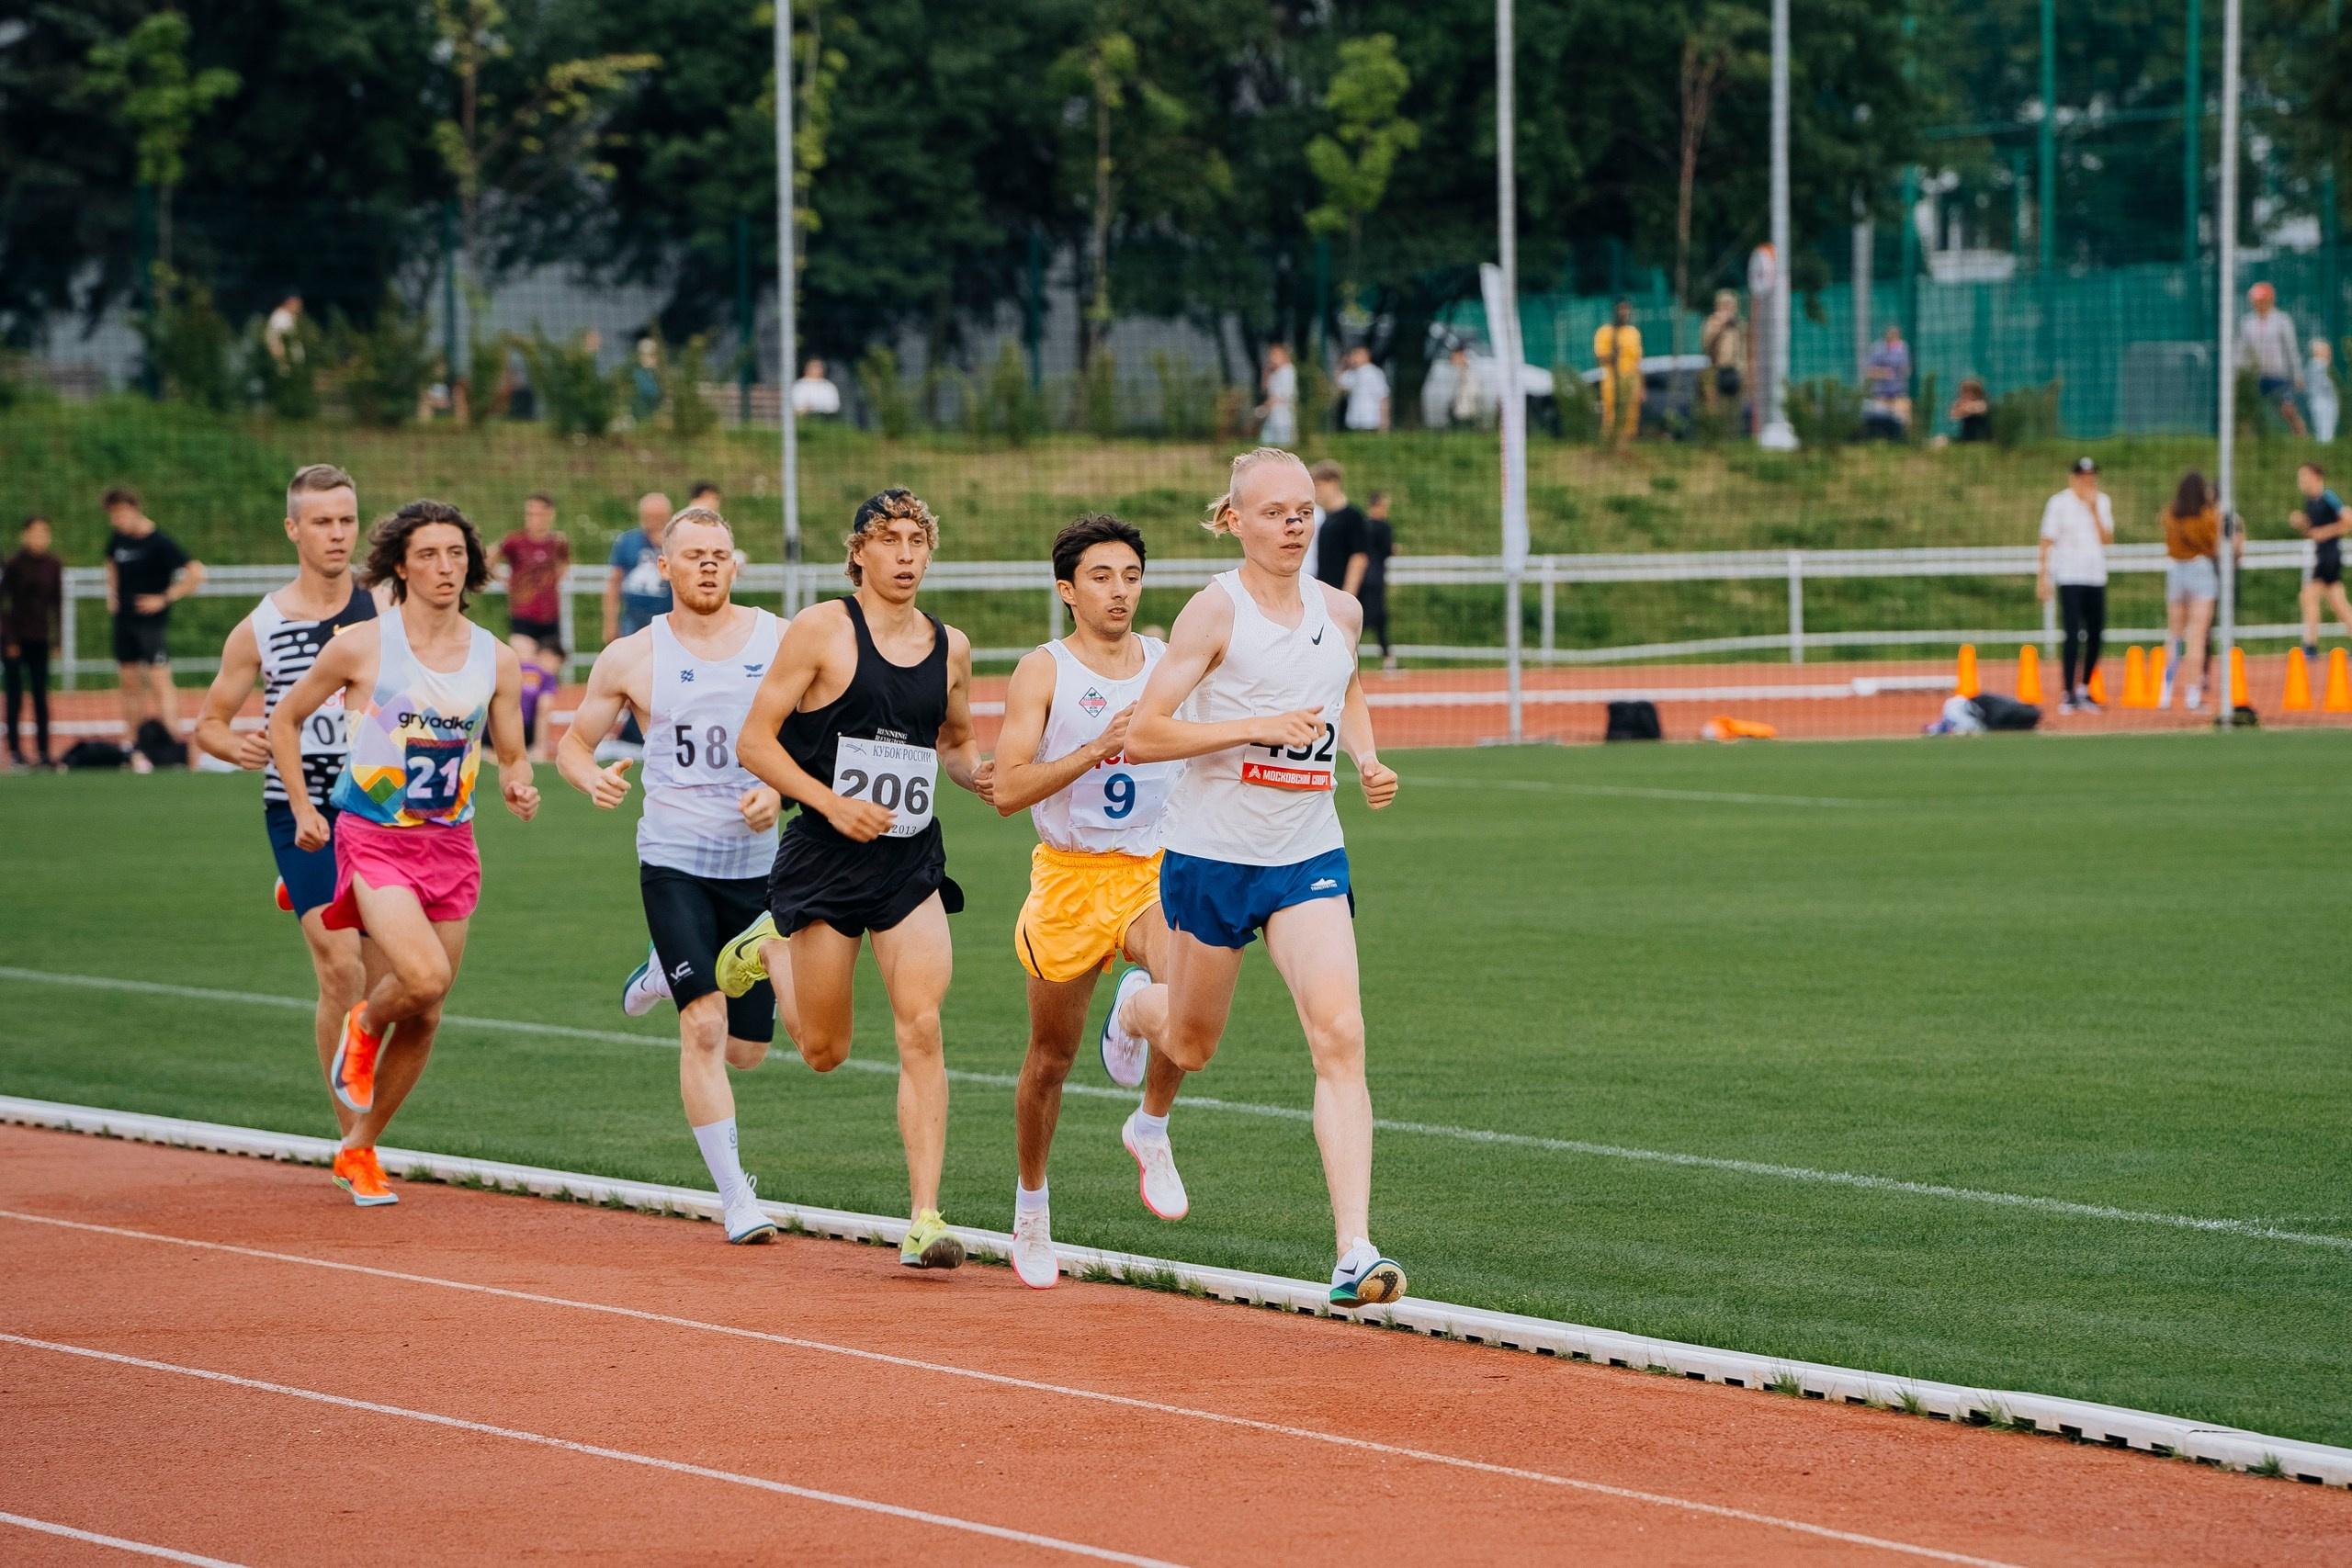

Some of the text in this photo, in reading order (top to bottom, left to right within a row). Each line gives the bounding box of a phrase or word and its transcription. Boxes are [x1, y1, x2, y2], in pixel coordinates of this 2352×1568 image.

[398, 711, 474, 732] gryadka
[873, 745, 932, 763] КУБОК РОССИИ
[406, 756, 461, 799] 21
[1262, 769, 1329, 786] МОСКОВСКИЙ СПОРТ
[839, 768, 930, 816] 206
[1102, 773, 1136, 819] 9
[891, 824, 917, 836] 2013
